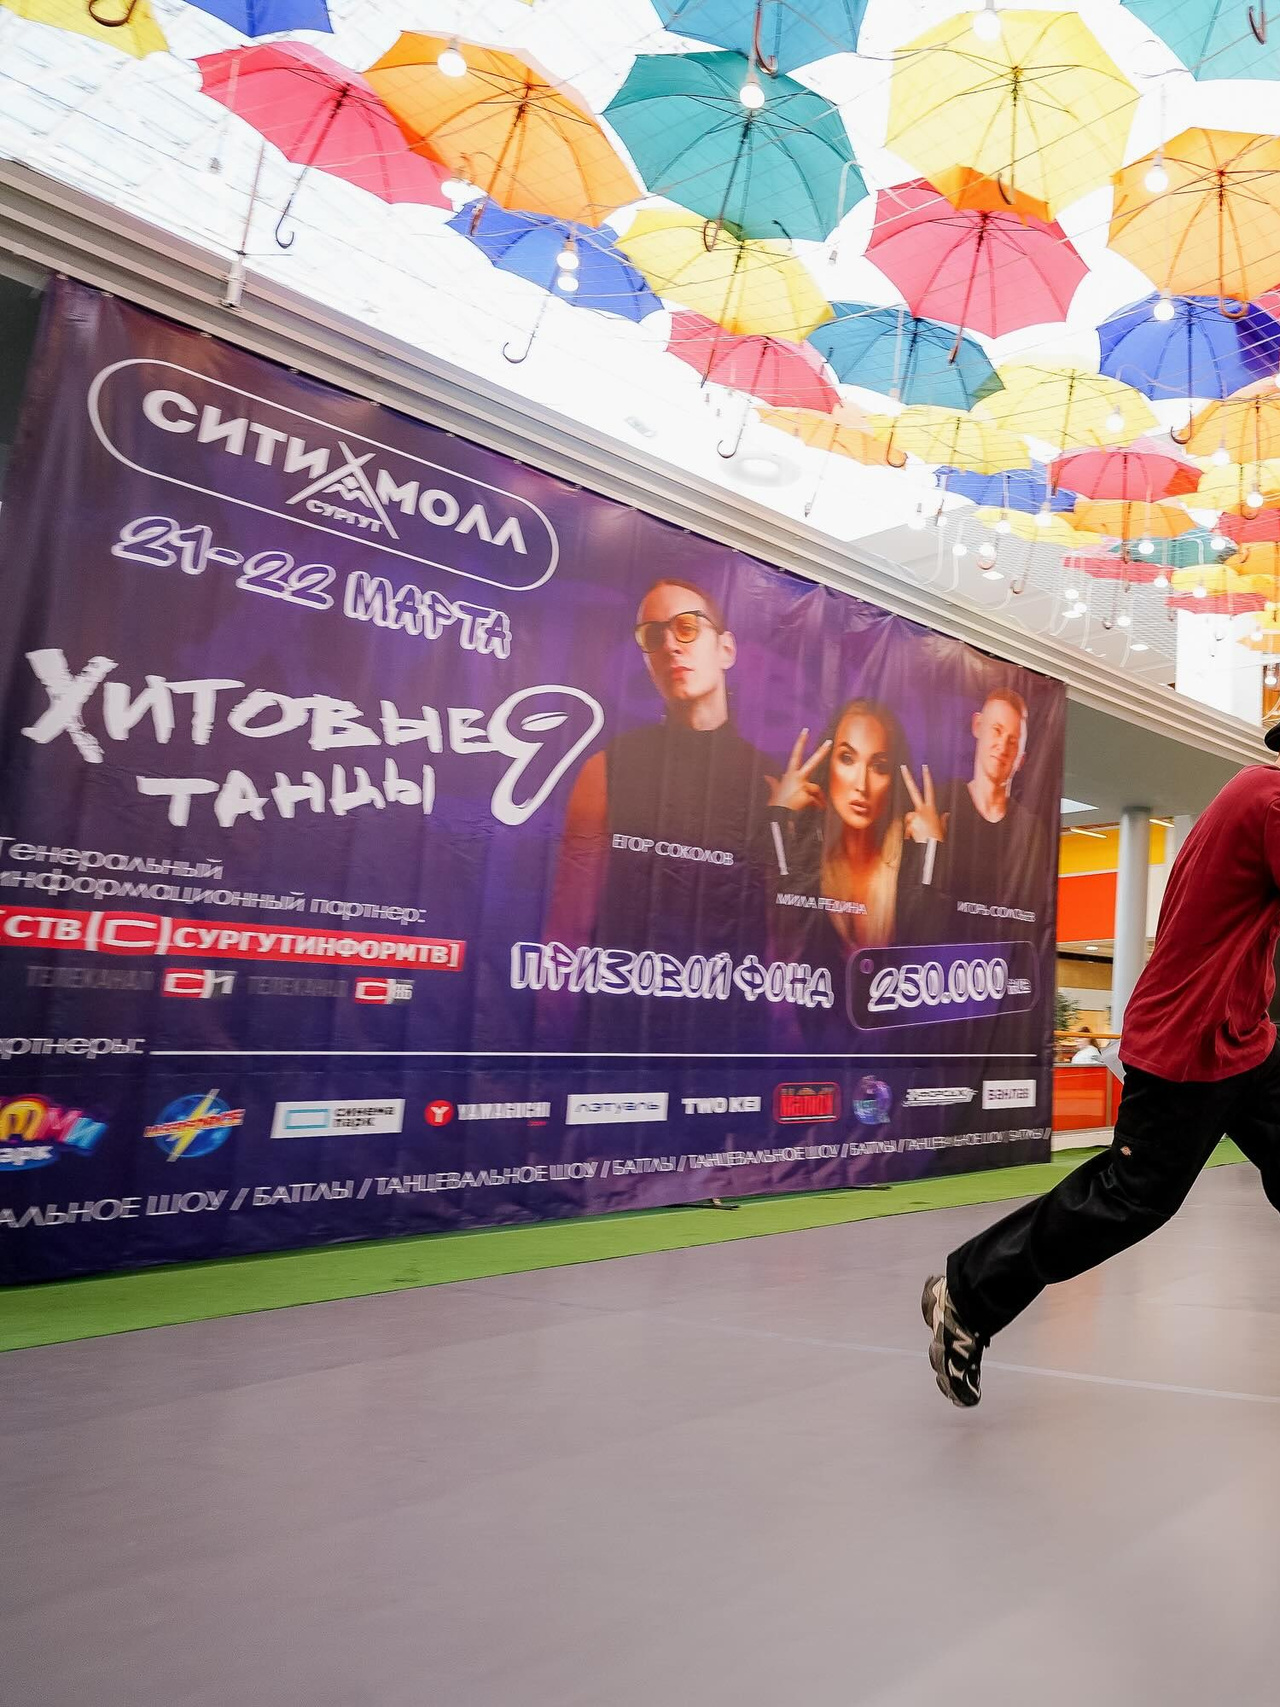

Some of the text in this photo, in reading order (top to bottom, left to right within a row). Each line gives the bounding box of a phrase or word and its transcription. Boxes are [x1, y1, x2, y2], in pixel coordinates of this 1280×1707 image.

[142, 388, 528, 555] СИТИ МОЛЛ
[305, 498, 384, 534] СУРГУТ
[110, 515, 513, 660] 21-22 МАРТА
[20, 648, 499, 764] ХИТОВЫЕ
[136, 758, 436, 829] ТАНЦЫ
[612, 834, 735, 866] ЕГОР СОКОЛОВ
[510, 941, 835, 1008] ПРИЗОВОЙ ФОНД
[867, 957, 1009, 1012] 250.000
[0, 1037, 146, 1059] ртнеры:
[146, 1189, 229, 1216] ШОУ
